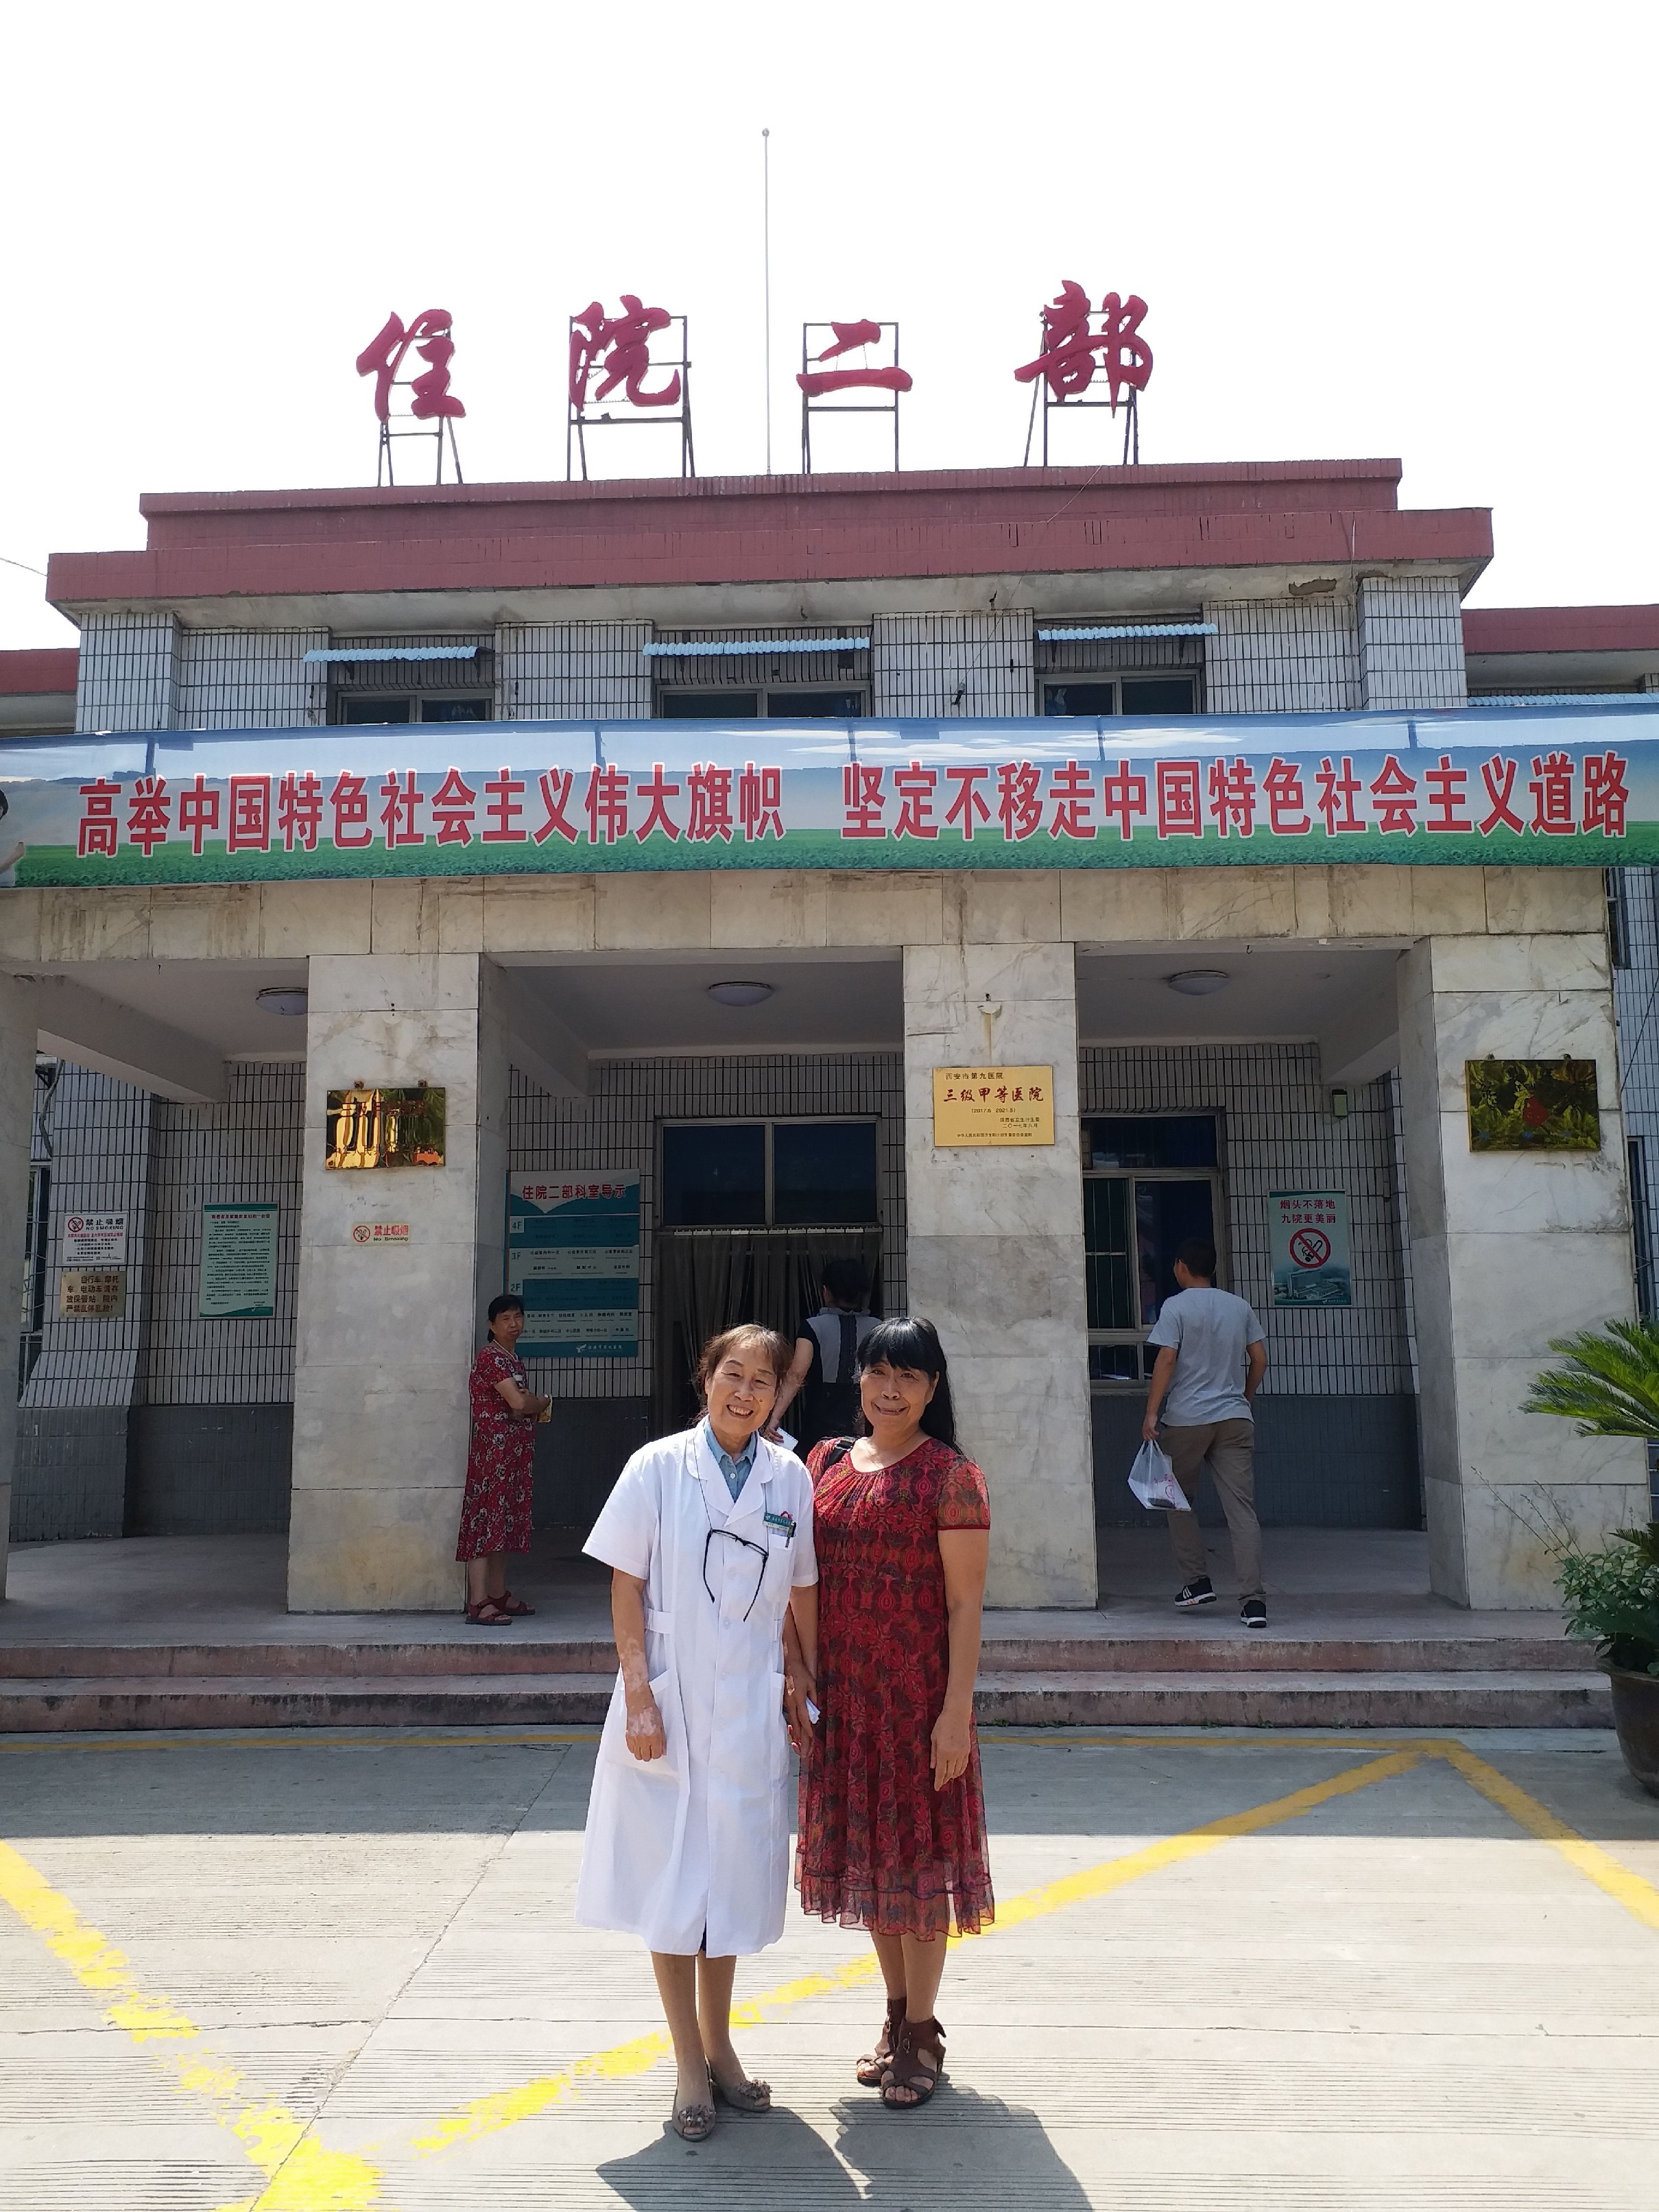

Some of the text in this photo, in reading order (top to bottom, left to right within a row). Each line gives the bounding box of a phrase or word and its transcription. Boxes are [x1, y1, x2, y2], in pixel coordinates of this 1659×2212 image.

[357, 280, 1154, 423] 住院二部
[77, 750, 1631, 857] 高举中国特色社会主义伟大旗帜 坚定不移走中国特色社会主义道路
[945, 1072, 1004, 1080] 西安市第九医院
[943, 1085, 1045, 1104] 三级甲等医院
[522, 1184, 627, 1200] 住院二部科室导示
[1280, 1200, 1335, 1209] 烟头不落地
[1281, 1213, 1336, 1224] 九院更美丽
[374, 1224, 409, 1236] 禁止吸烟
[511, 1222, 522, 1230] 4F
[511, 1252, 521, 1260] 3F
[81, 1276, 102, 1284] 自行车
[510, 1284, 521, 1292] 2F
